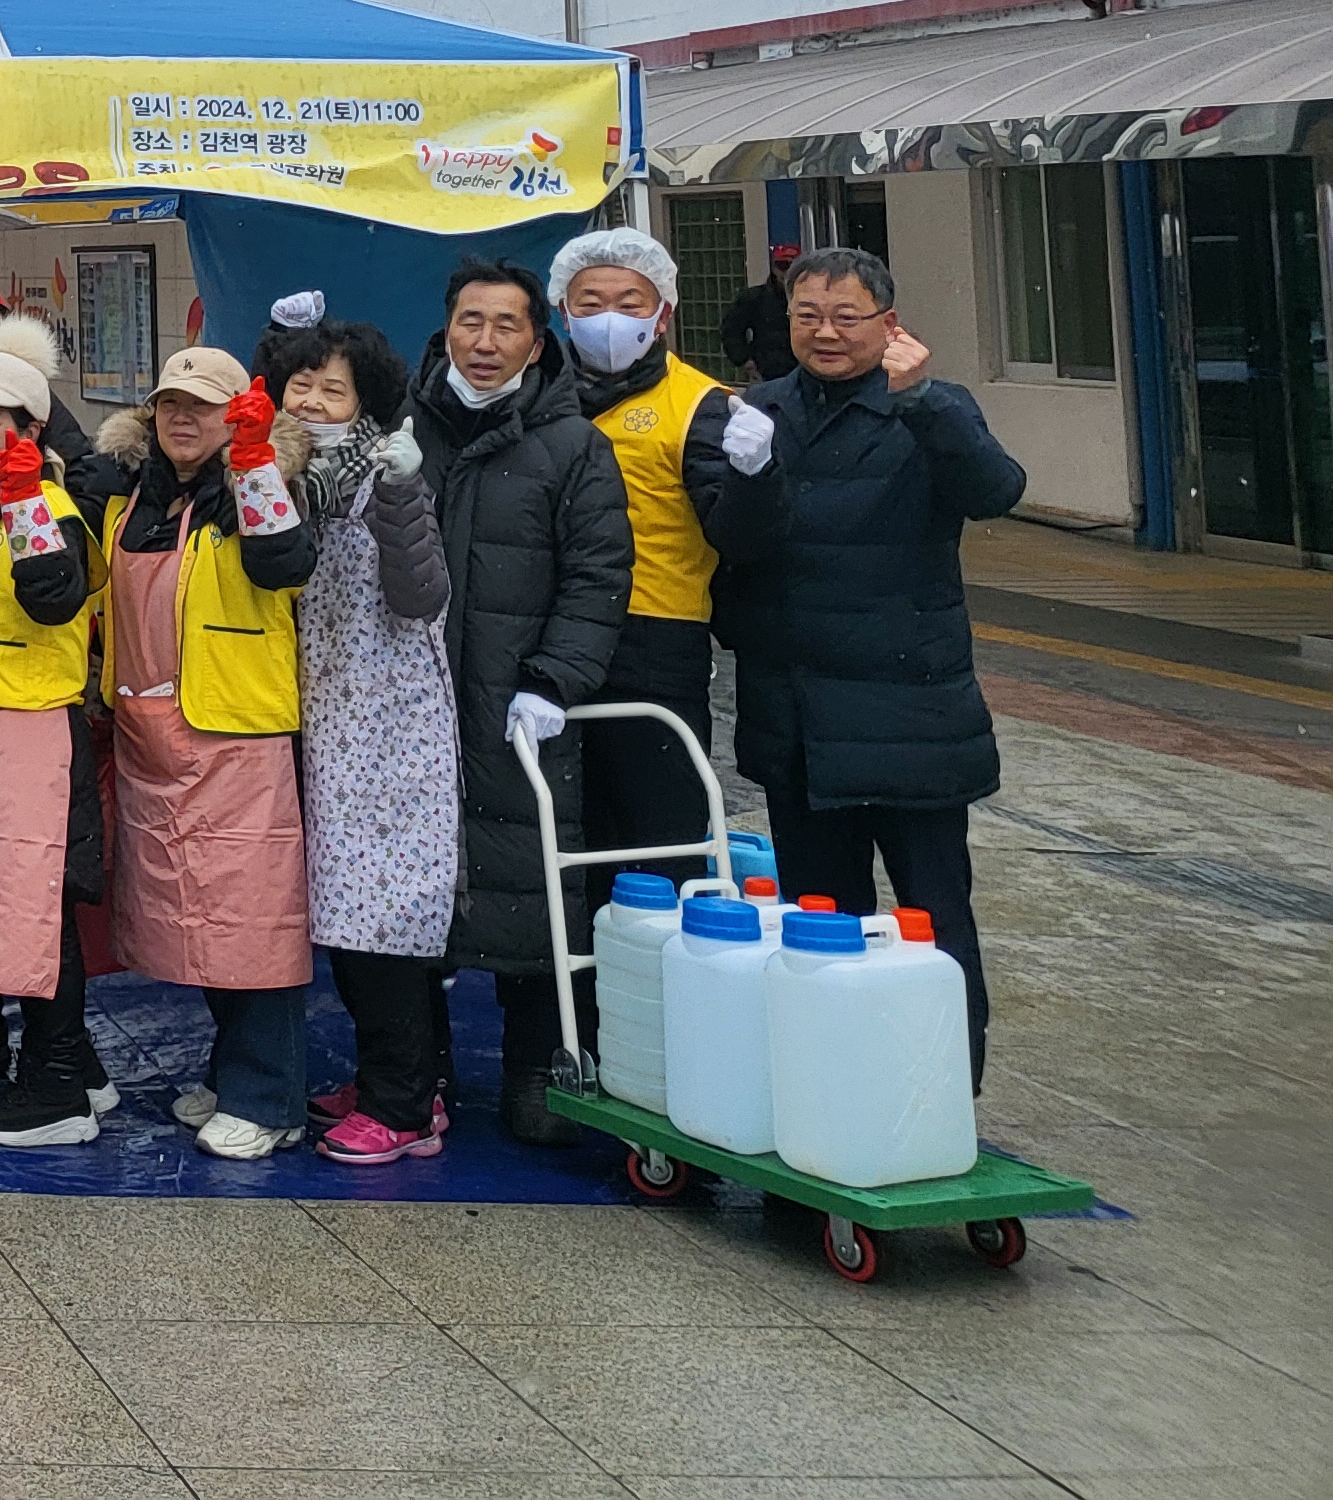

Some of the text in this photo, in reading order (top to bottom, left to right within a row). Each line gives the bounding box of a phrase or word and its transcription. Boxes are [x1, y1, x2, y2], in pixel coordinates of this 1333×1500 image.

[131, 96, 172, 118] 일시
[197, 98, 253, 119] 2024.
[261, 101, 293, 120] 12.
[300, 101, 420, 123] 21(토)11:00
[132, 130, 173, 152] 장소
[200, 131, 258, 153] 김천역
[266, 133, 307, 155] 광장
[436, 169, 503, 190] together
[509, 165, 568, 196] 김천
